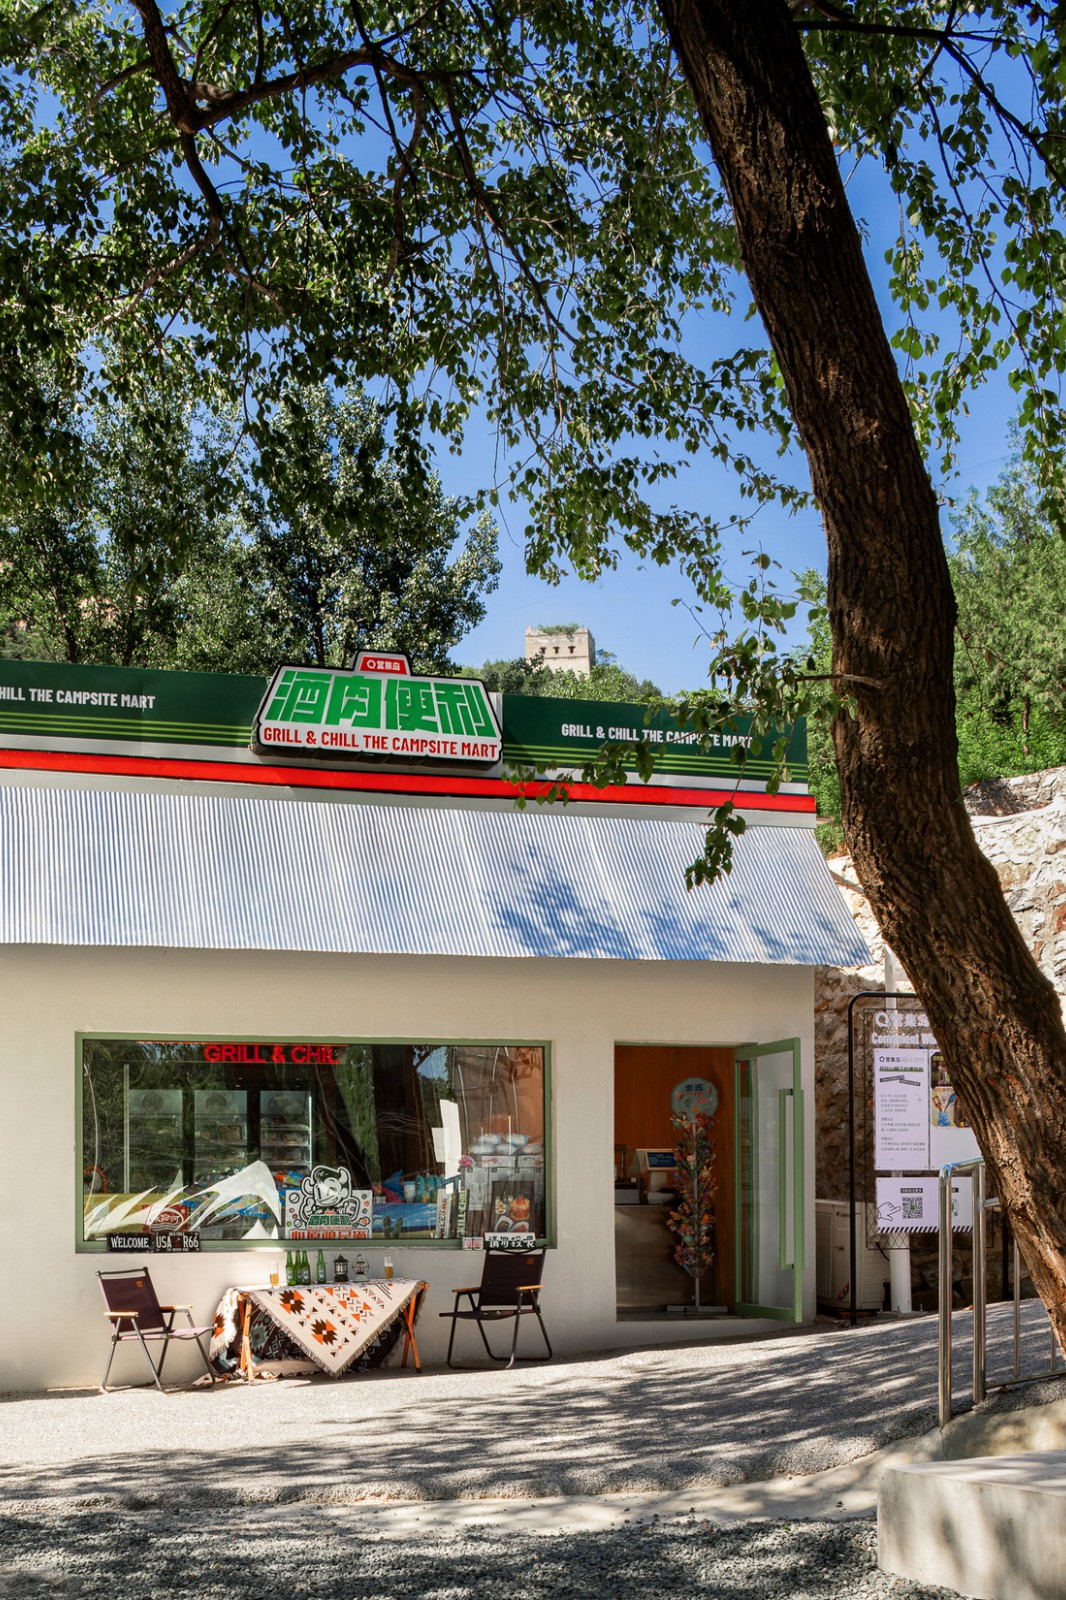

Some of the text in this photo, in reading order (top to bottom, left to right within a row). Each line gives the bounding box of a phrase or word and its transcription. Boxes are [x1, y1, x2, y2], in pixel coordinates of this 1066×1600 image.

[29, 688, 53, 702] THE
[56, 690, 118, 706] CAMPSITE
[121, 694, 155, 708] MART
[263, 727, 497, 757] GRILL & CHILL THE CAMPSITE MART
[561, 723, 593, 737] GRILL
[596, 726, 605, 738] &
[608, 726, 640, 741] CHILL
[642, 729, 663, 743] THE
[203, 1045, 266, 1063] GRILL
[271, 1045, 285, 1063] &
[110, 1235, 150, 1248] WELCOME
[156, 1236, 199, 1248] USA R66
